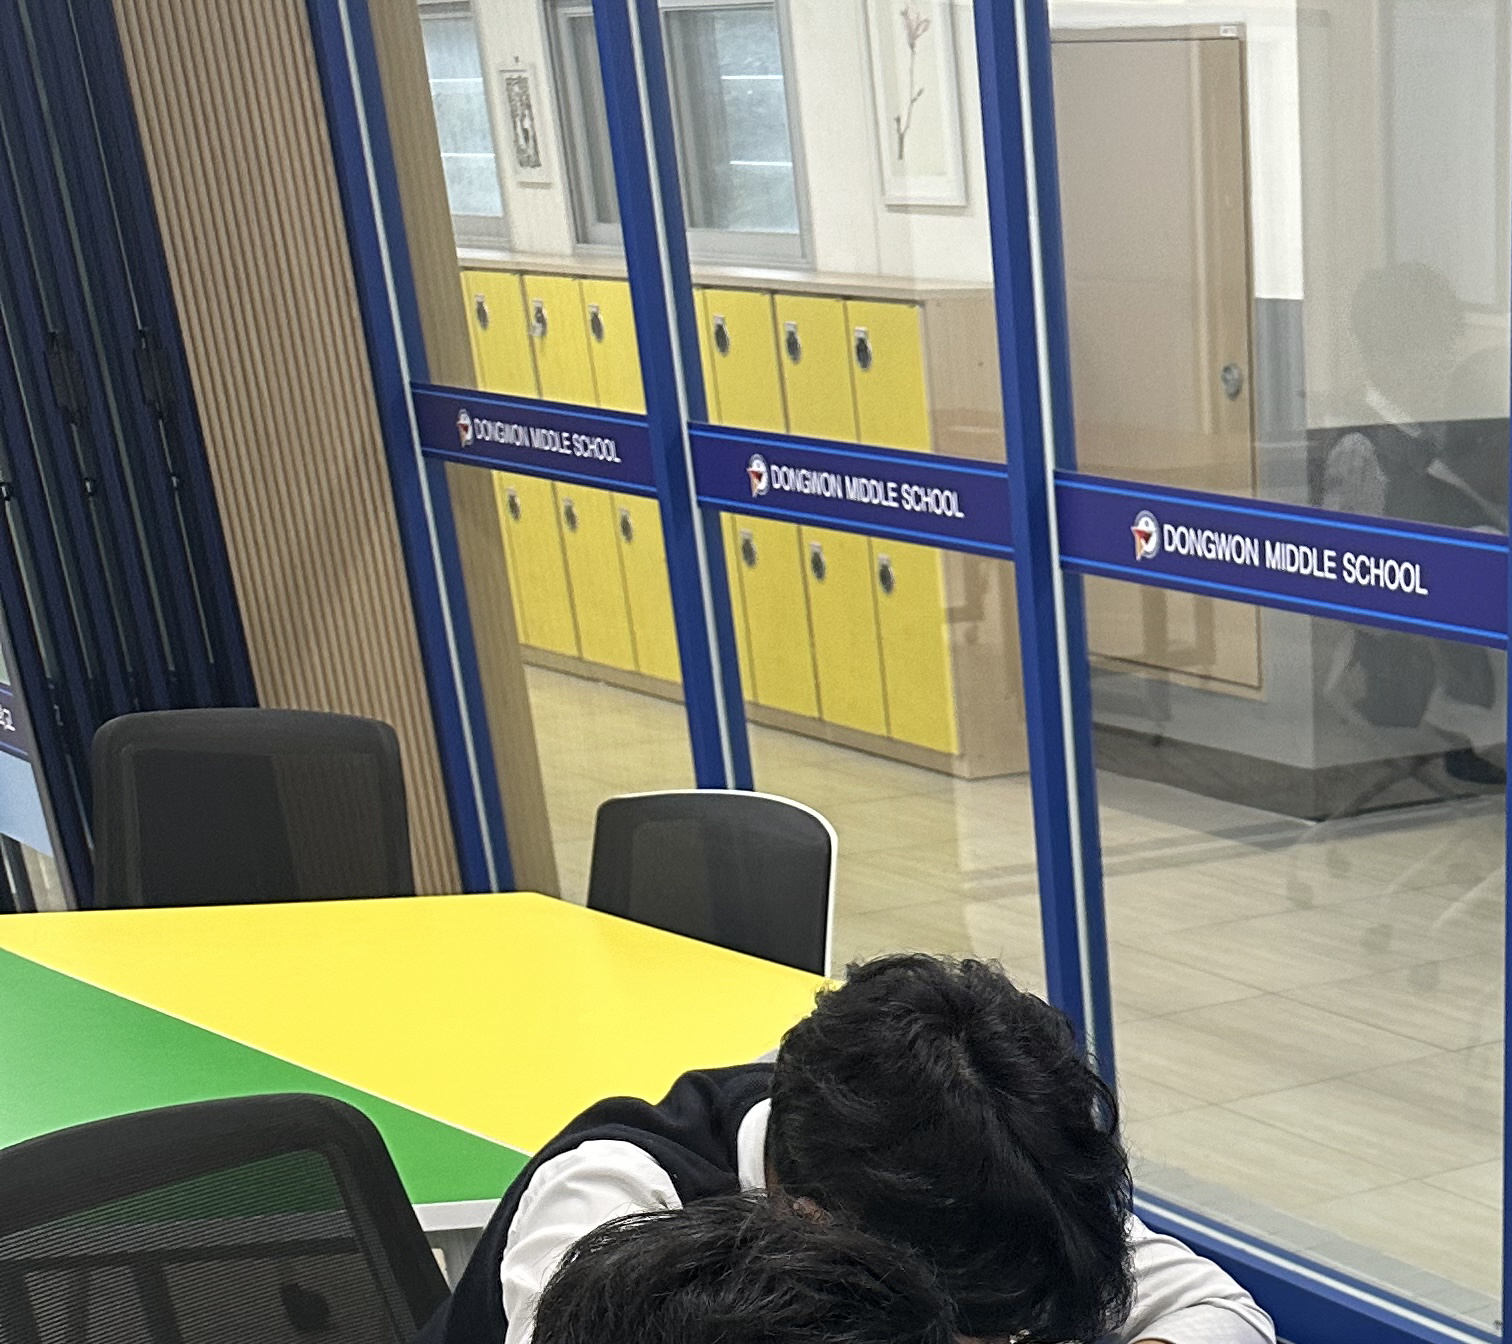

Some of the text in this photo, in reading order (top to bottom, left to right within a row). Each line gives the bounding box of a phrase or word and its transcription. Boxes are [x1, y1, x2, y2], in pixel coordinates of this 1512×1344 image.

[474, 419, 621, 462] DONGWON MIDDLE SCHOOL
[771, 465, 964, 517] DONGWON MIDDLE SCHOOL
[1164, 524, 1428, 594] DONGWON MIDDLE SCHOOL
